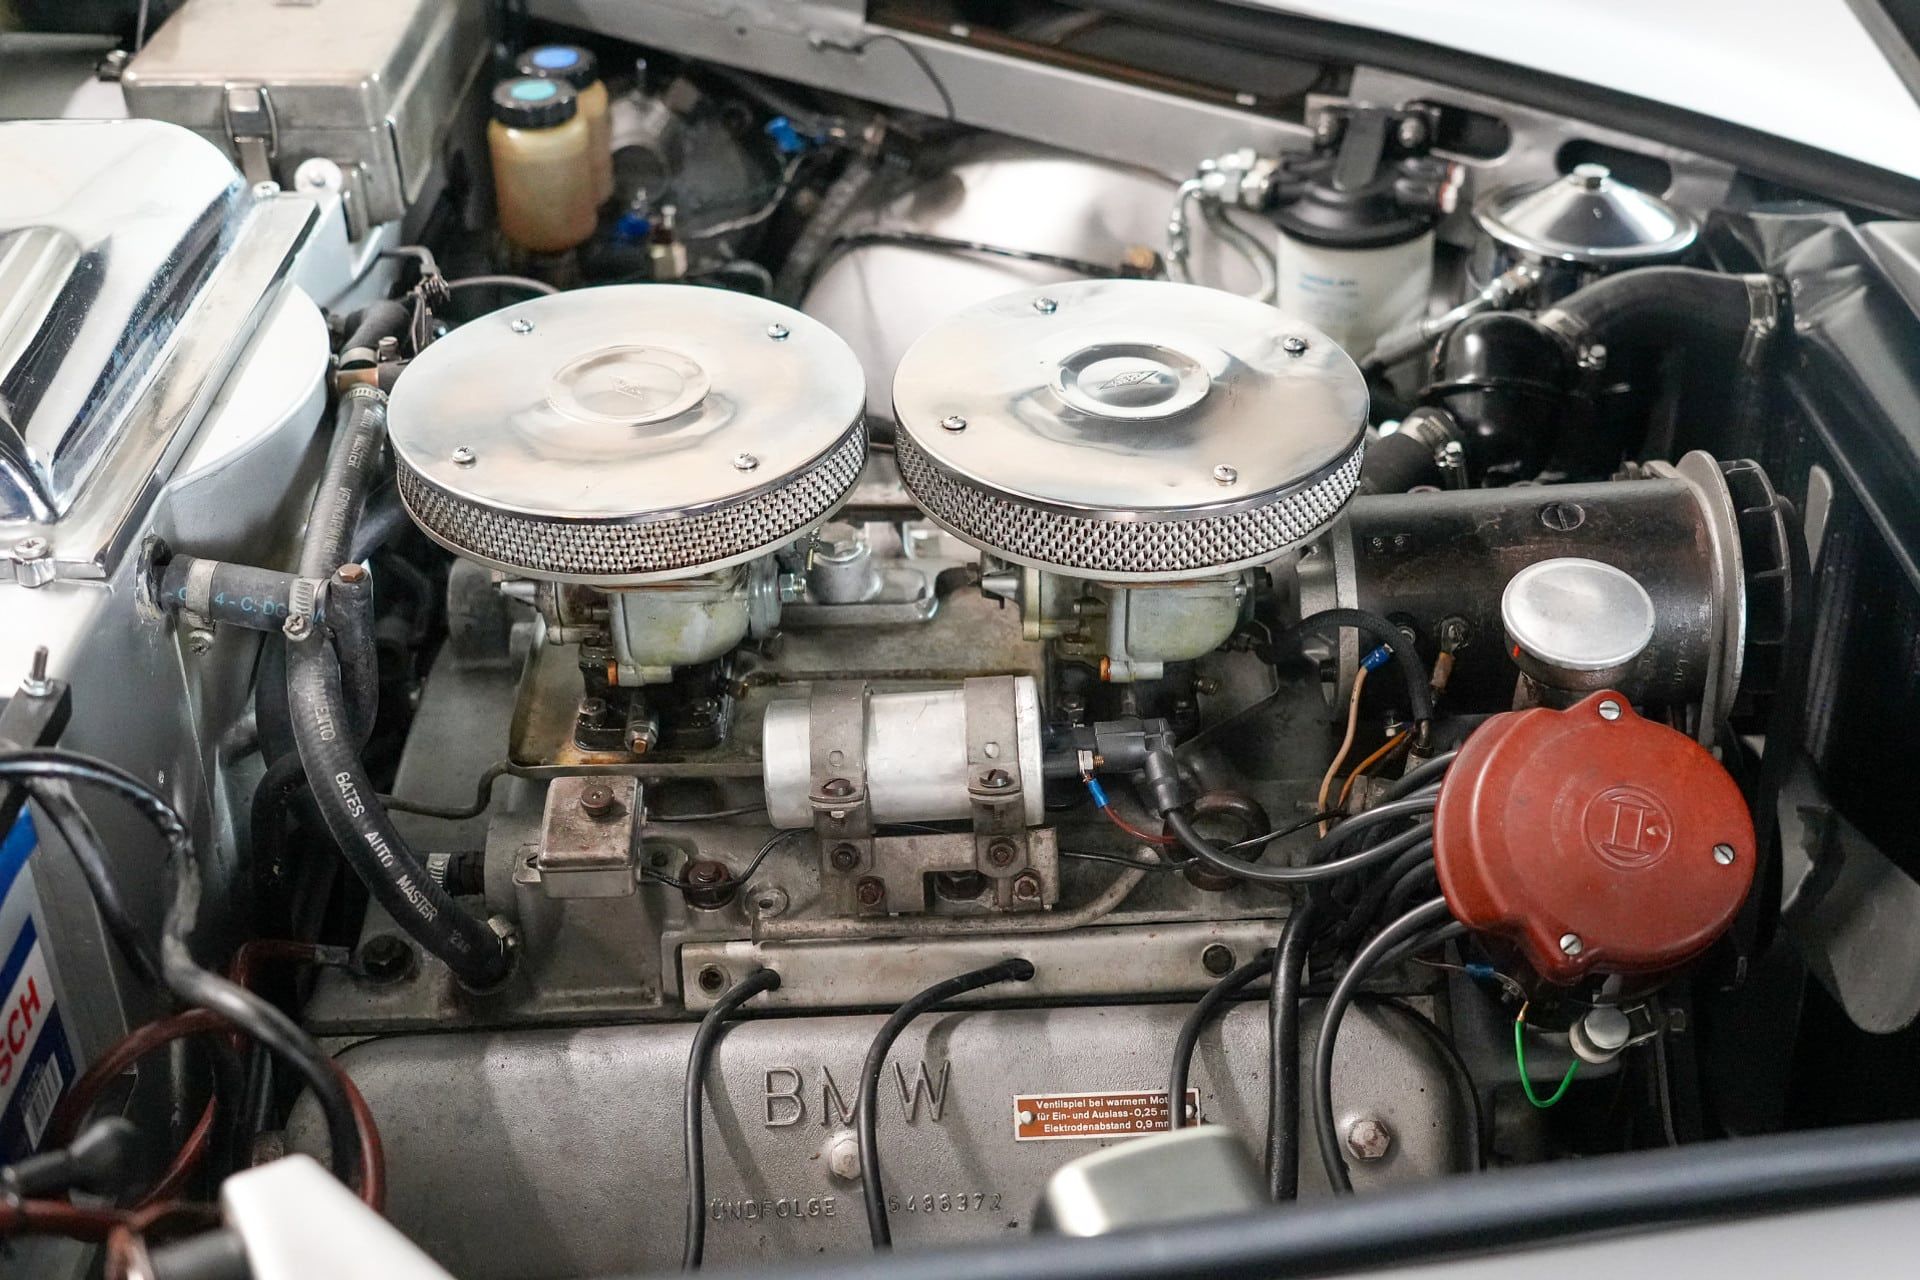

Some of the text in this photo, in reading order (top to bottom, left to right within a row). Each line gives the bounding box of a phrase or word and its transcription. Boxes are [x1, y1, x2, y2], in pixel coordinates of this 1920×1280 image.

[335, 771, 365, 818] GATES
[364, 831, 394, 868] AUTO
[396, 873, 438, 923] MASTER
[1036, 1096, 1168, 1109] Ventilspiel bei warmem Mot
[1037, 1112, 1050, 1121] für
[1052, 1111, 1071, 1120] Ein-
[1072, 1110, 1090, 1119] und
[1044, 1120, 1131, 1133] Elektrodenabstand
[1136, 1119, 1153, 1130] 0,9
